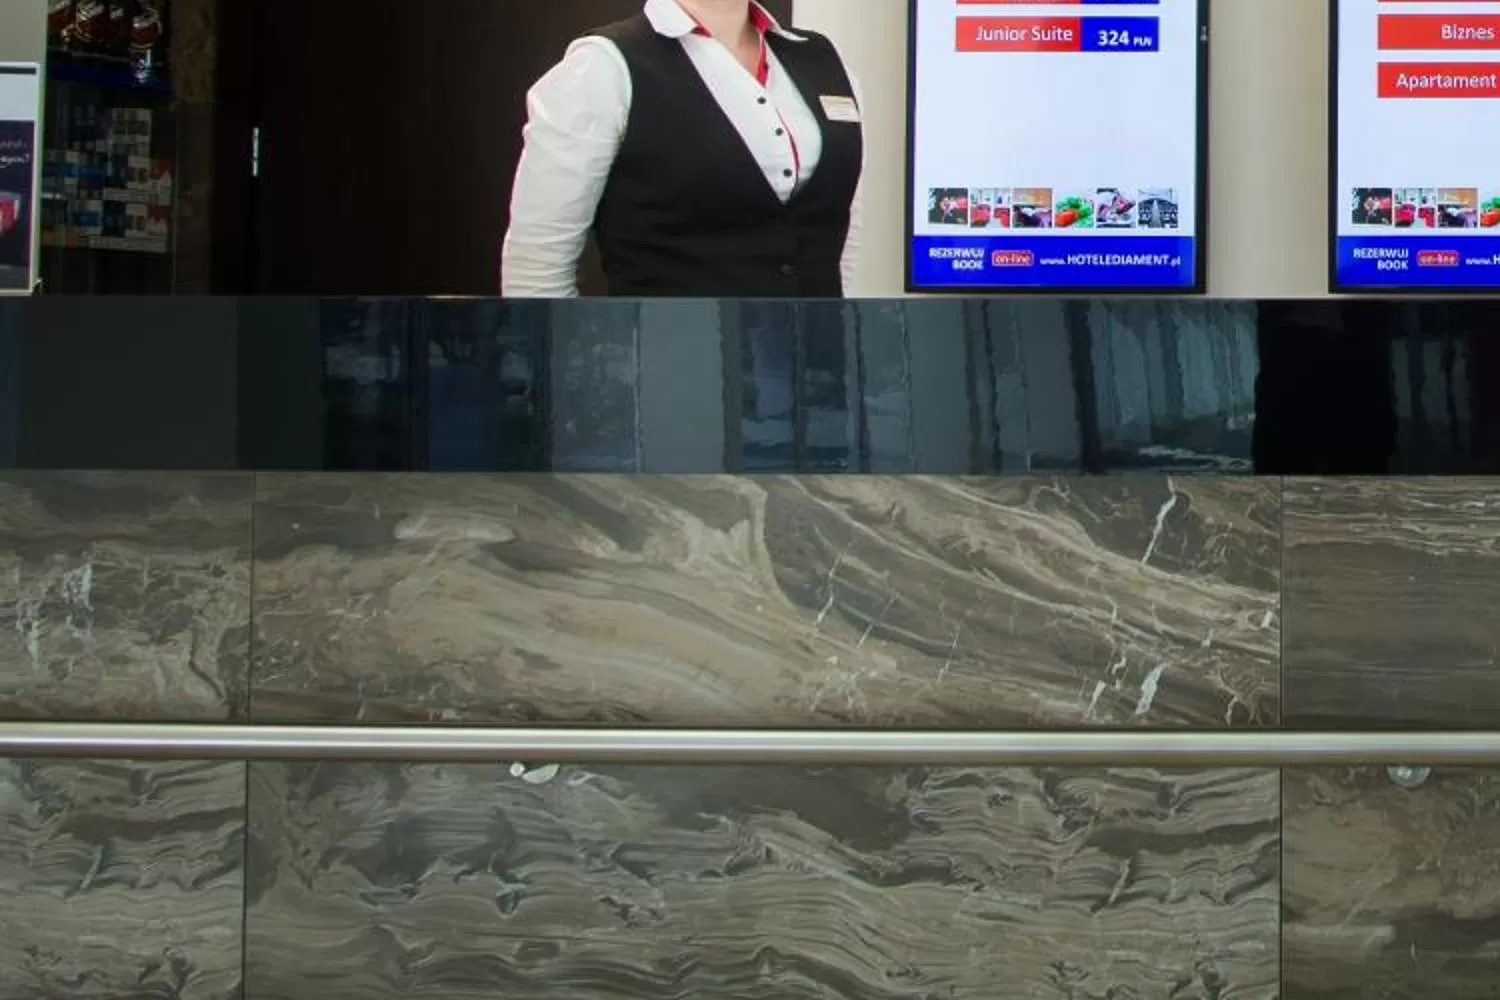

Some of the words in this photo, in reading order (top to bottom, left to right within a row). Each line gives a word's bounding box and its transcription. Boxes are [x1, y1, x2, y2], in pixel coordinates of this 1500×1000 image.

[975, 26, 1028, 41] Junior
[1030, 25, 1073, 41] Suite
[1097, 30, 1130, 46] 324
[1133, 36, 1152, 47] PLN
[1440, 23, 1496, 40] Biznes
[1395, 71, 1498, 90] Apartament
[1376, 259, 1409, 271] BOOK
